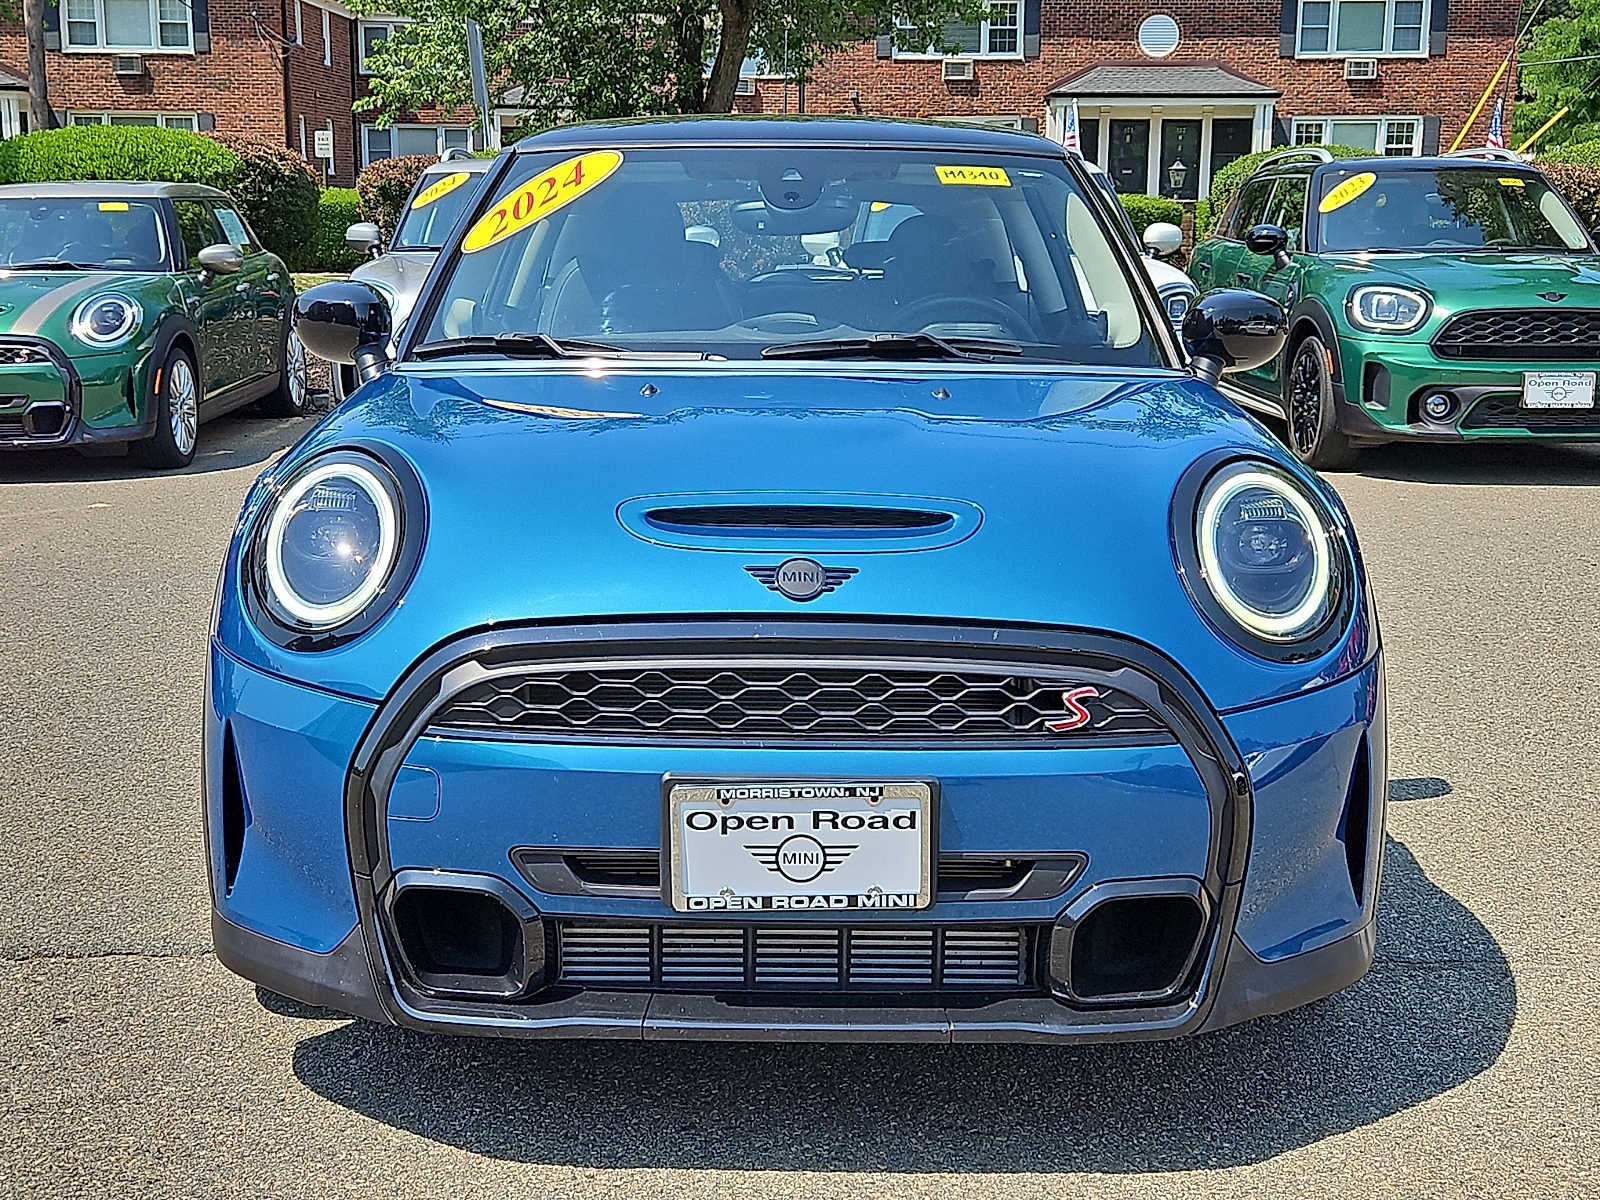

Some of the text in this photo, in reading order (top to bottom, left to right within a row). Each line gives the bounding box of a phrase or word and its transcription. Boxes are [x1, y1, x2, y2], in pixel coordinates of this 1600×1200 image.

[1331, 176, 1366, 204] 2023
[489, 159, 586, 242] 2024
[1528, 379, 1592, 387] Open Road
[782, 571, 819, 583] MINI
[1044, 686, 1099, 732] S
[720, 787, 880, 799] MORRISTOWN, NJ
[686, 811, 917, 835] Open Road
[782, 852, 819, 865] MINI
[689, 894, 914, 910] OPEN ROAD MINI
